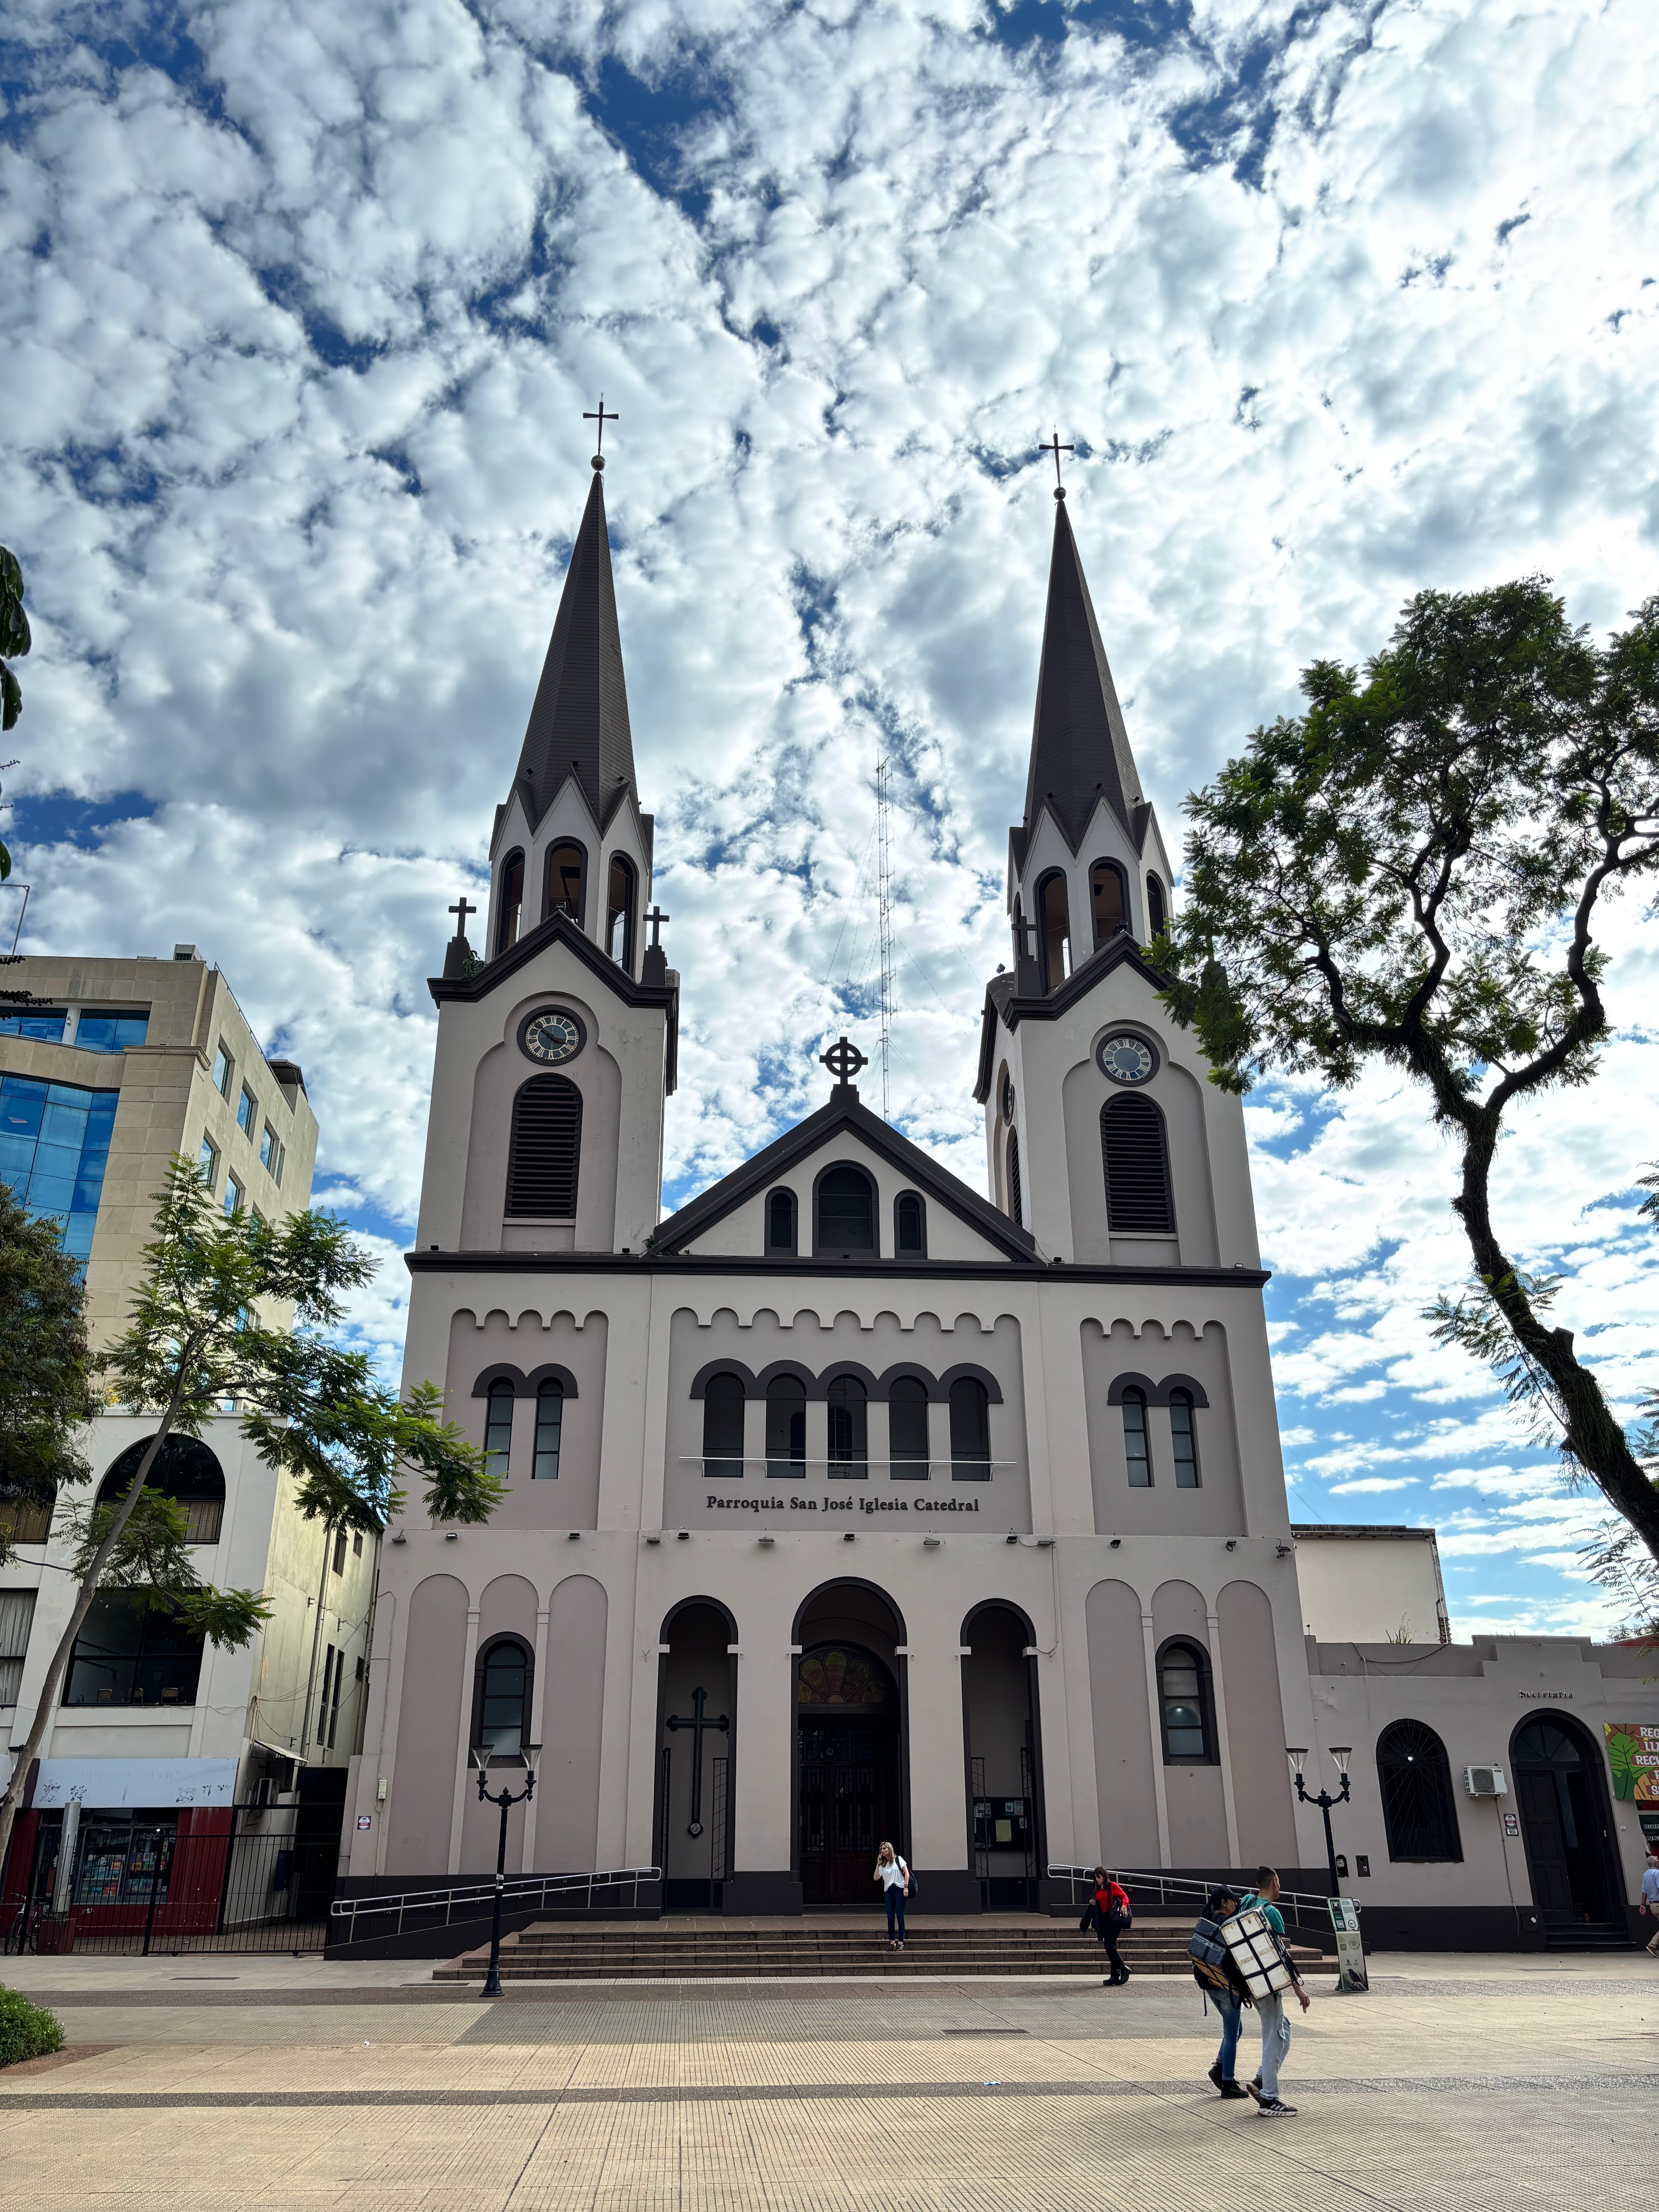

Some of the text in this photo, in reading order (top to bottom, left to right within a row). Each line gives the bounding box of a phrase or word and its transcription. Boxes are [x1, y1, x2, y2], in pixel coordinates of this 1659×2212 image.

[706, 1496, 980, 1514] Parroquia San José Iglesia Catedral
[1640, 1727, 1659, 1738] REG
[1635, 1755, 1659, 1765] RECU
[1651, 1785, 1659, 1795] S
